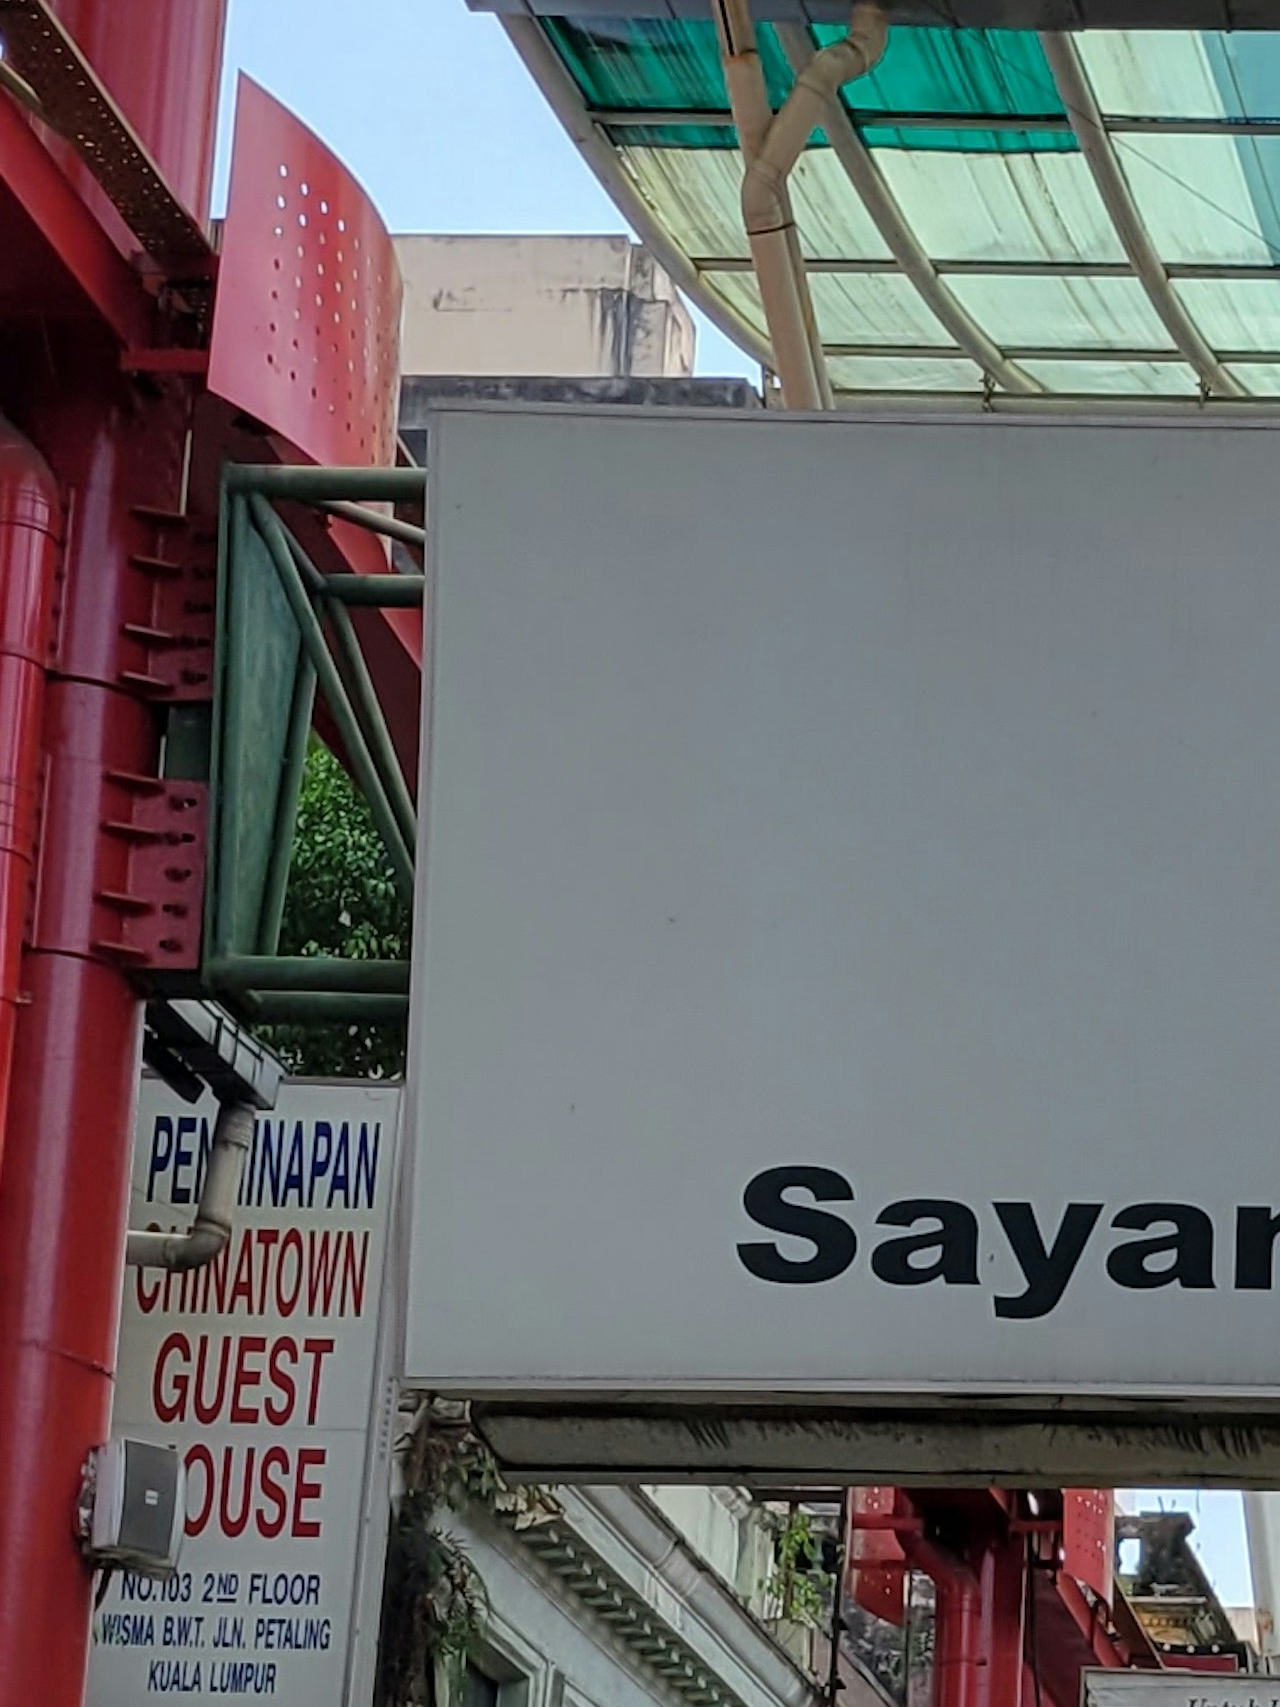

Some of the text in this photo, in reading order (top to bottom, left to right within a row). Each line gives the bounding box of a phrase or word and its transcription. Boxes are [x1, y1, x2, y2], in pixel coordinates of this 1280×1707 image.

[146, 1115, 382, 1210] PENINAPAN
[151, 1332, 335, 1426] GUEST
[184, 1443, 327, 1539] OUSE
[202, 1573, 239, 1604] 2ND
[249, 1574, 321, 1605] FLOOR
[212, 1617, 247, 1650] JLN.
[254, 1618, 332, 1650] PETALING
[148, 1659, 278, 1694] KUALA LUMPUR
